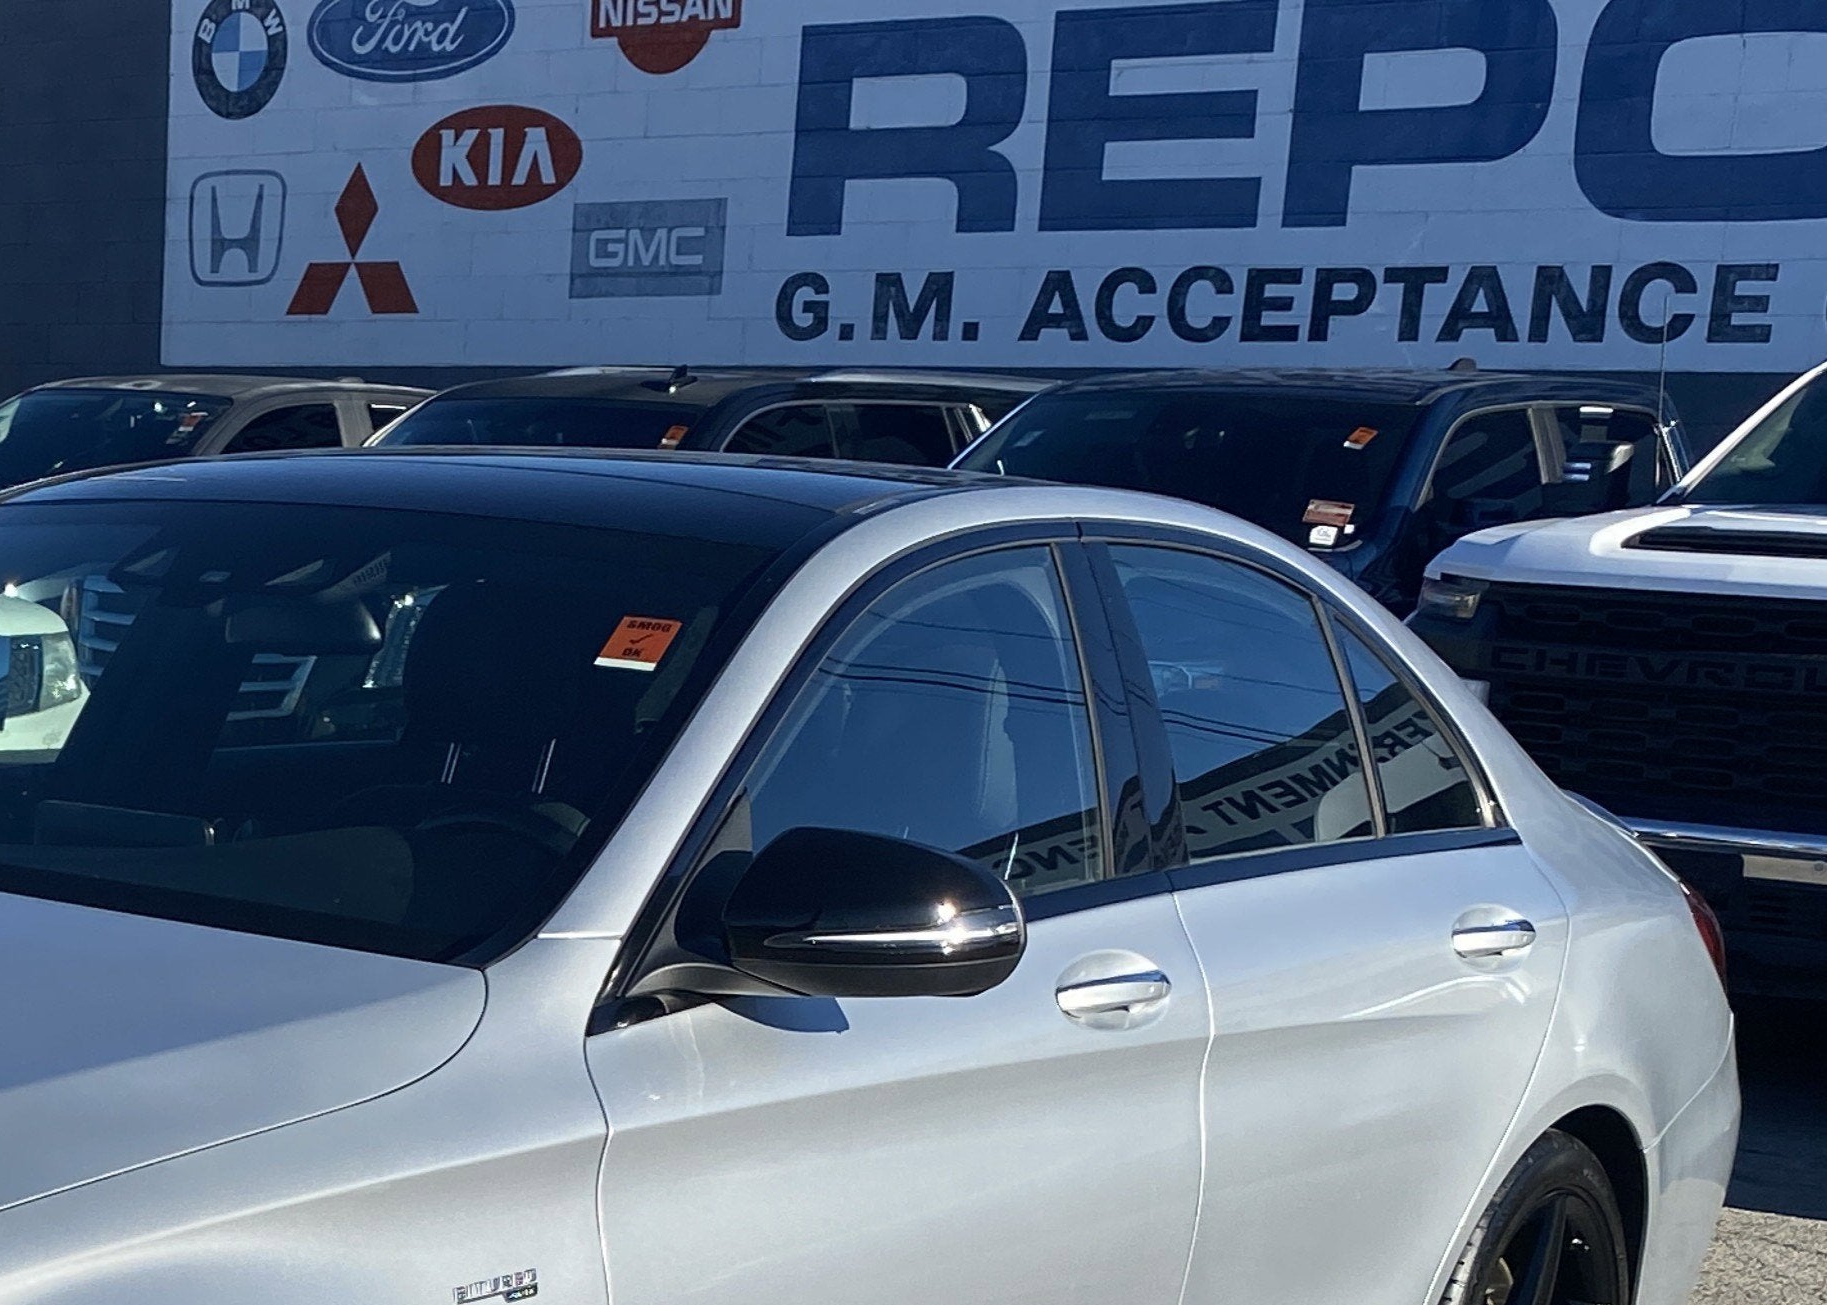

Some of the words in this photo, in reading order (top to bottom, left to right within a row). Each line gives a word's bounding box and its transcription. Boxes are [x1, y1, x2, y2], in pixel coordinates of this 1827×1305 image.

[351, 0, 469, 54] Ford
[598, 0, 733, 29] NISSAN
[438, 126, 557, 187] KIA
[589, 226, 706, 268] GMC
[774, 270, 981, 343] G.M.
[1017, 260, 1781, 344] ACCEPTANCE
